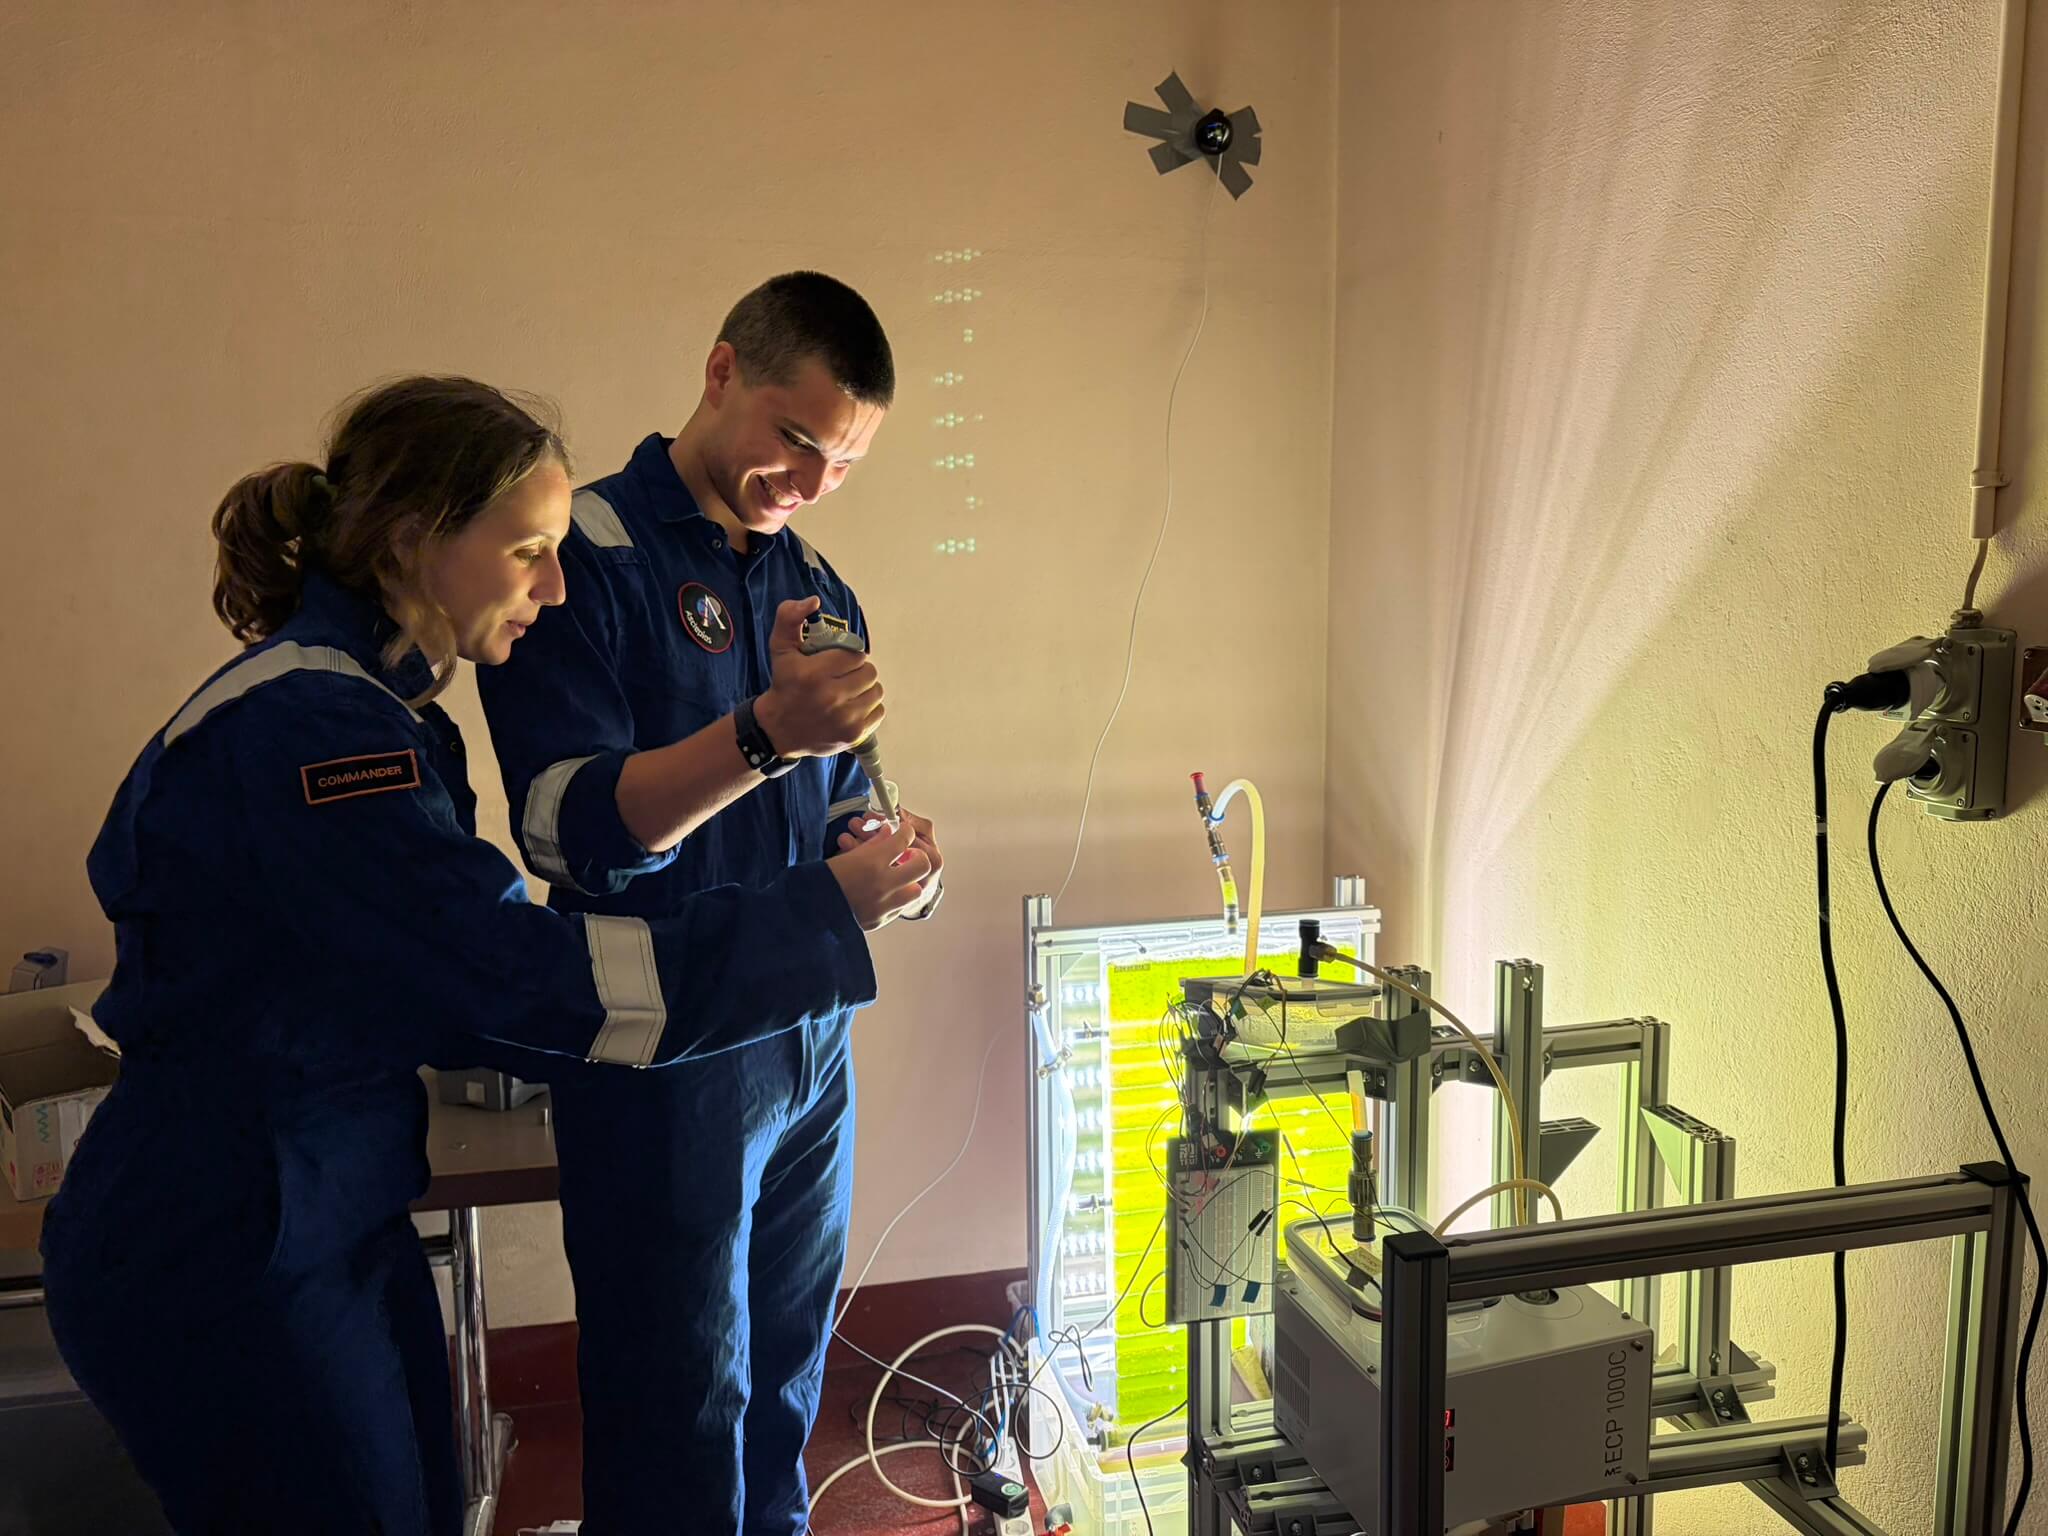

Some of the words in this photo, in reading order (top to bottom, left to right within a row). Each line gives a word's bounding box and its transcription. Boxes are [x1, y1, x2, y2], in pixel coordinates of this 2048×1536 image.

[317, 765, 403, 788] COMMANDER
[1606, 1349, 1627, 1414] 1000C
[1604, 1419, 1624, 1464] ECP
